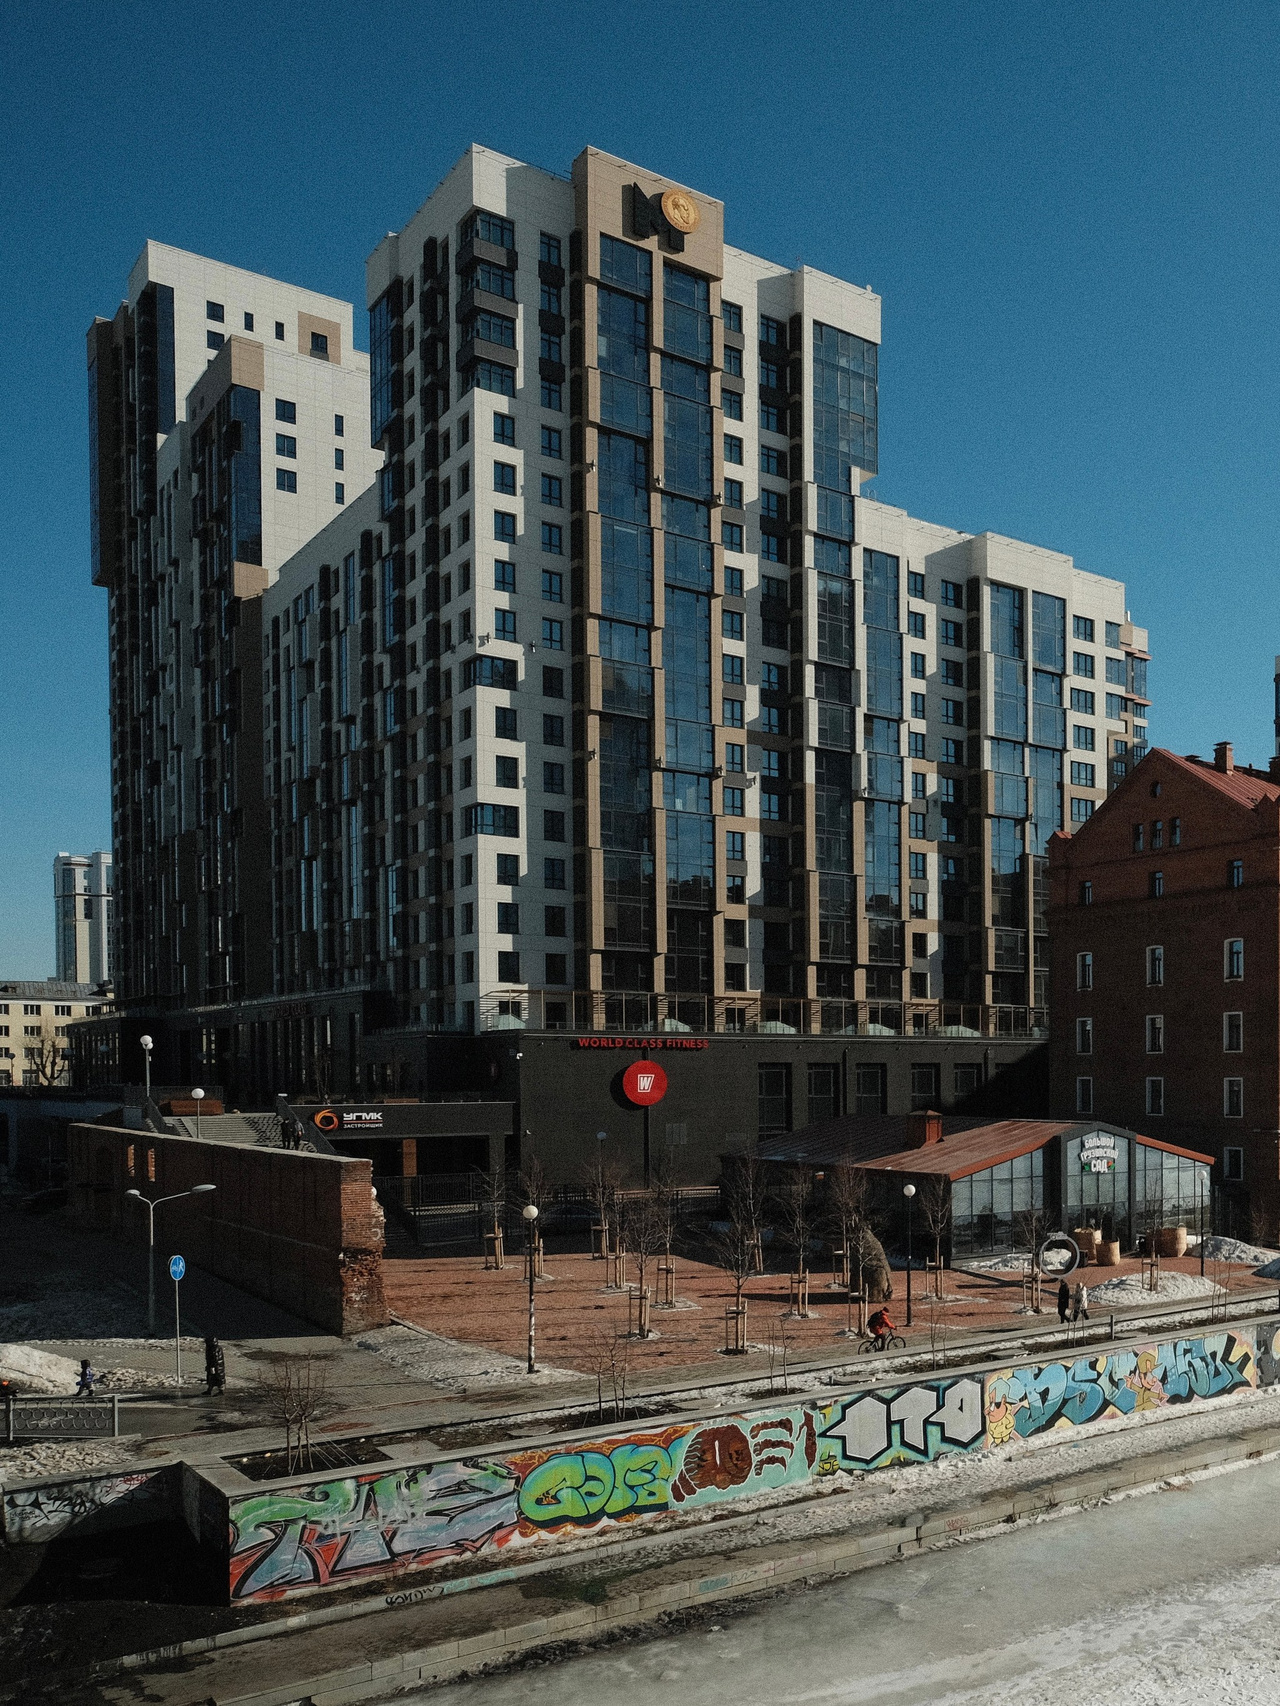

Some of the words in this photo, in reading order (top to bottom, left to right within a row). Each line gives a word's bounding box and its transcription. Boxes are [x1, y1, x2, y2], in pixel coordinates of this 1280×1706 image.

[578, 1037, 623, 1048] WORLD
[625, 1038, 663, 1048] CLASS
[666, 1038, 709, 1049] FITNESS
[343, 1112, 383, 1120] УГМК
[1085, 1136, 1114, 1149] БОЛЬШОЙ
[1091, 1159, 1108, 1173] САД
